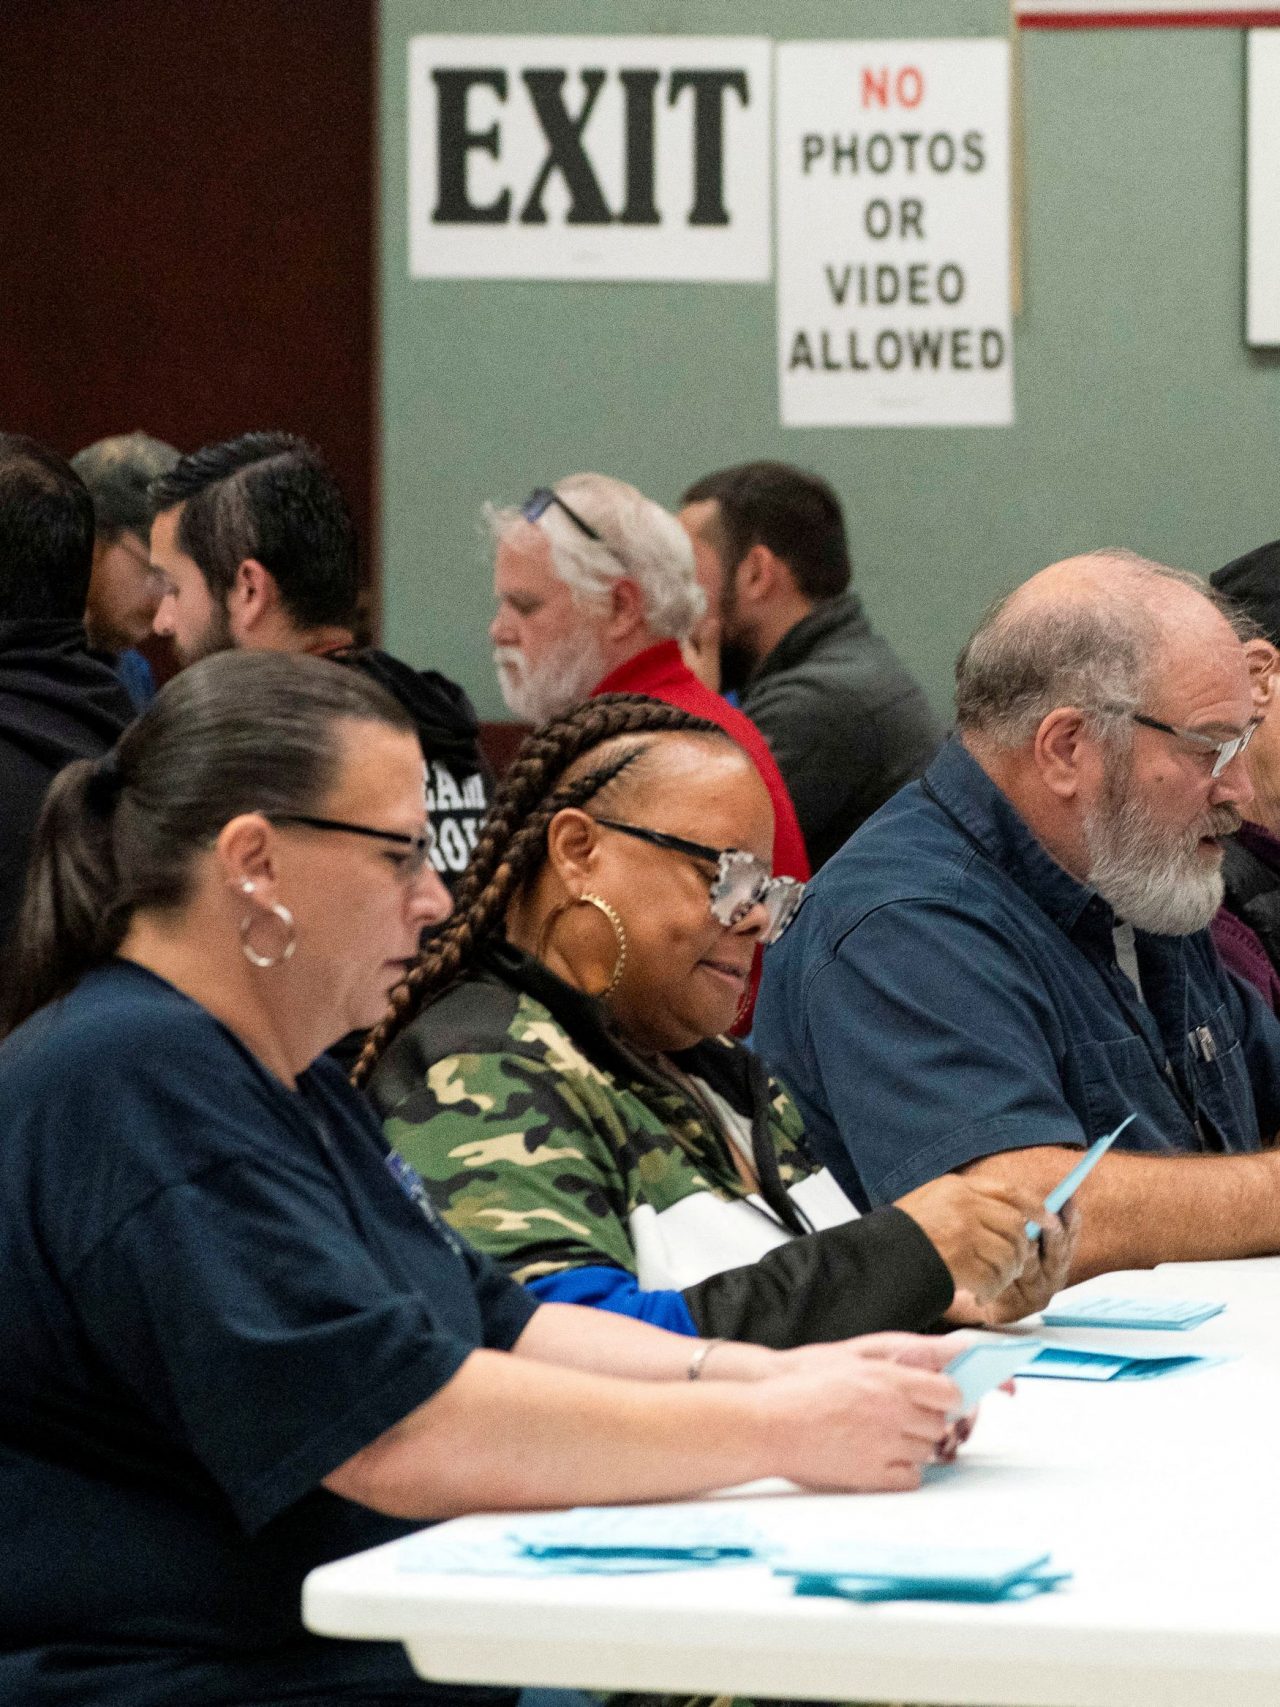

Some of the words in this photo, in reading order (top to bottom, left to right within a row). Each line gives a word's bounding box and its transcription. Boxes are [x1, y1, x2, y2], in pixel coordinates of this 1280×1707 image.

[861, 66, 926, 109] NO
[431, 68, 750, 226] EXIT
[802, 132, 986, 175] PHOTOS
[865, 199, 927, 240] OR
[825, 263, 966, 306] VIDEO
[789, 327, 1006, 372] ALLOWED
